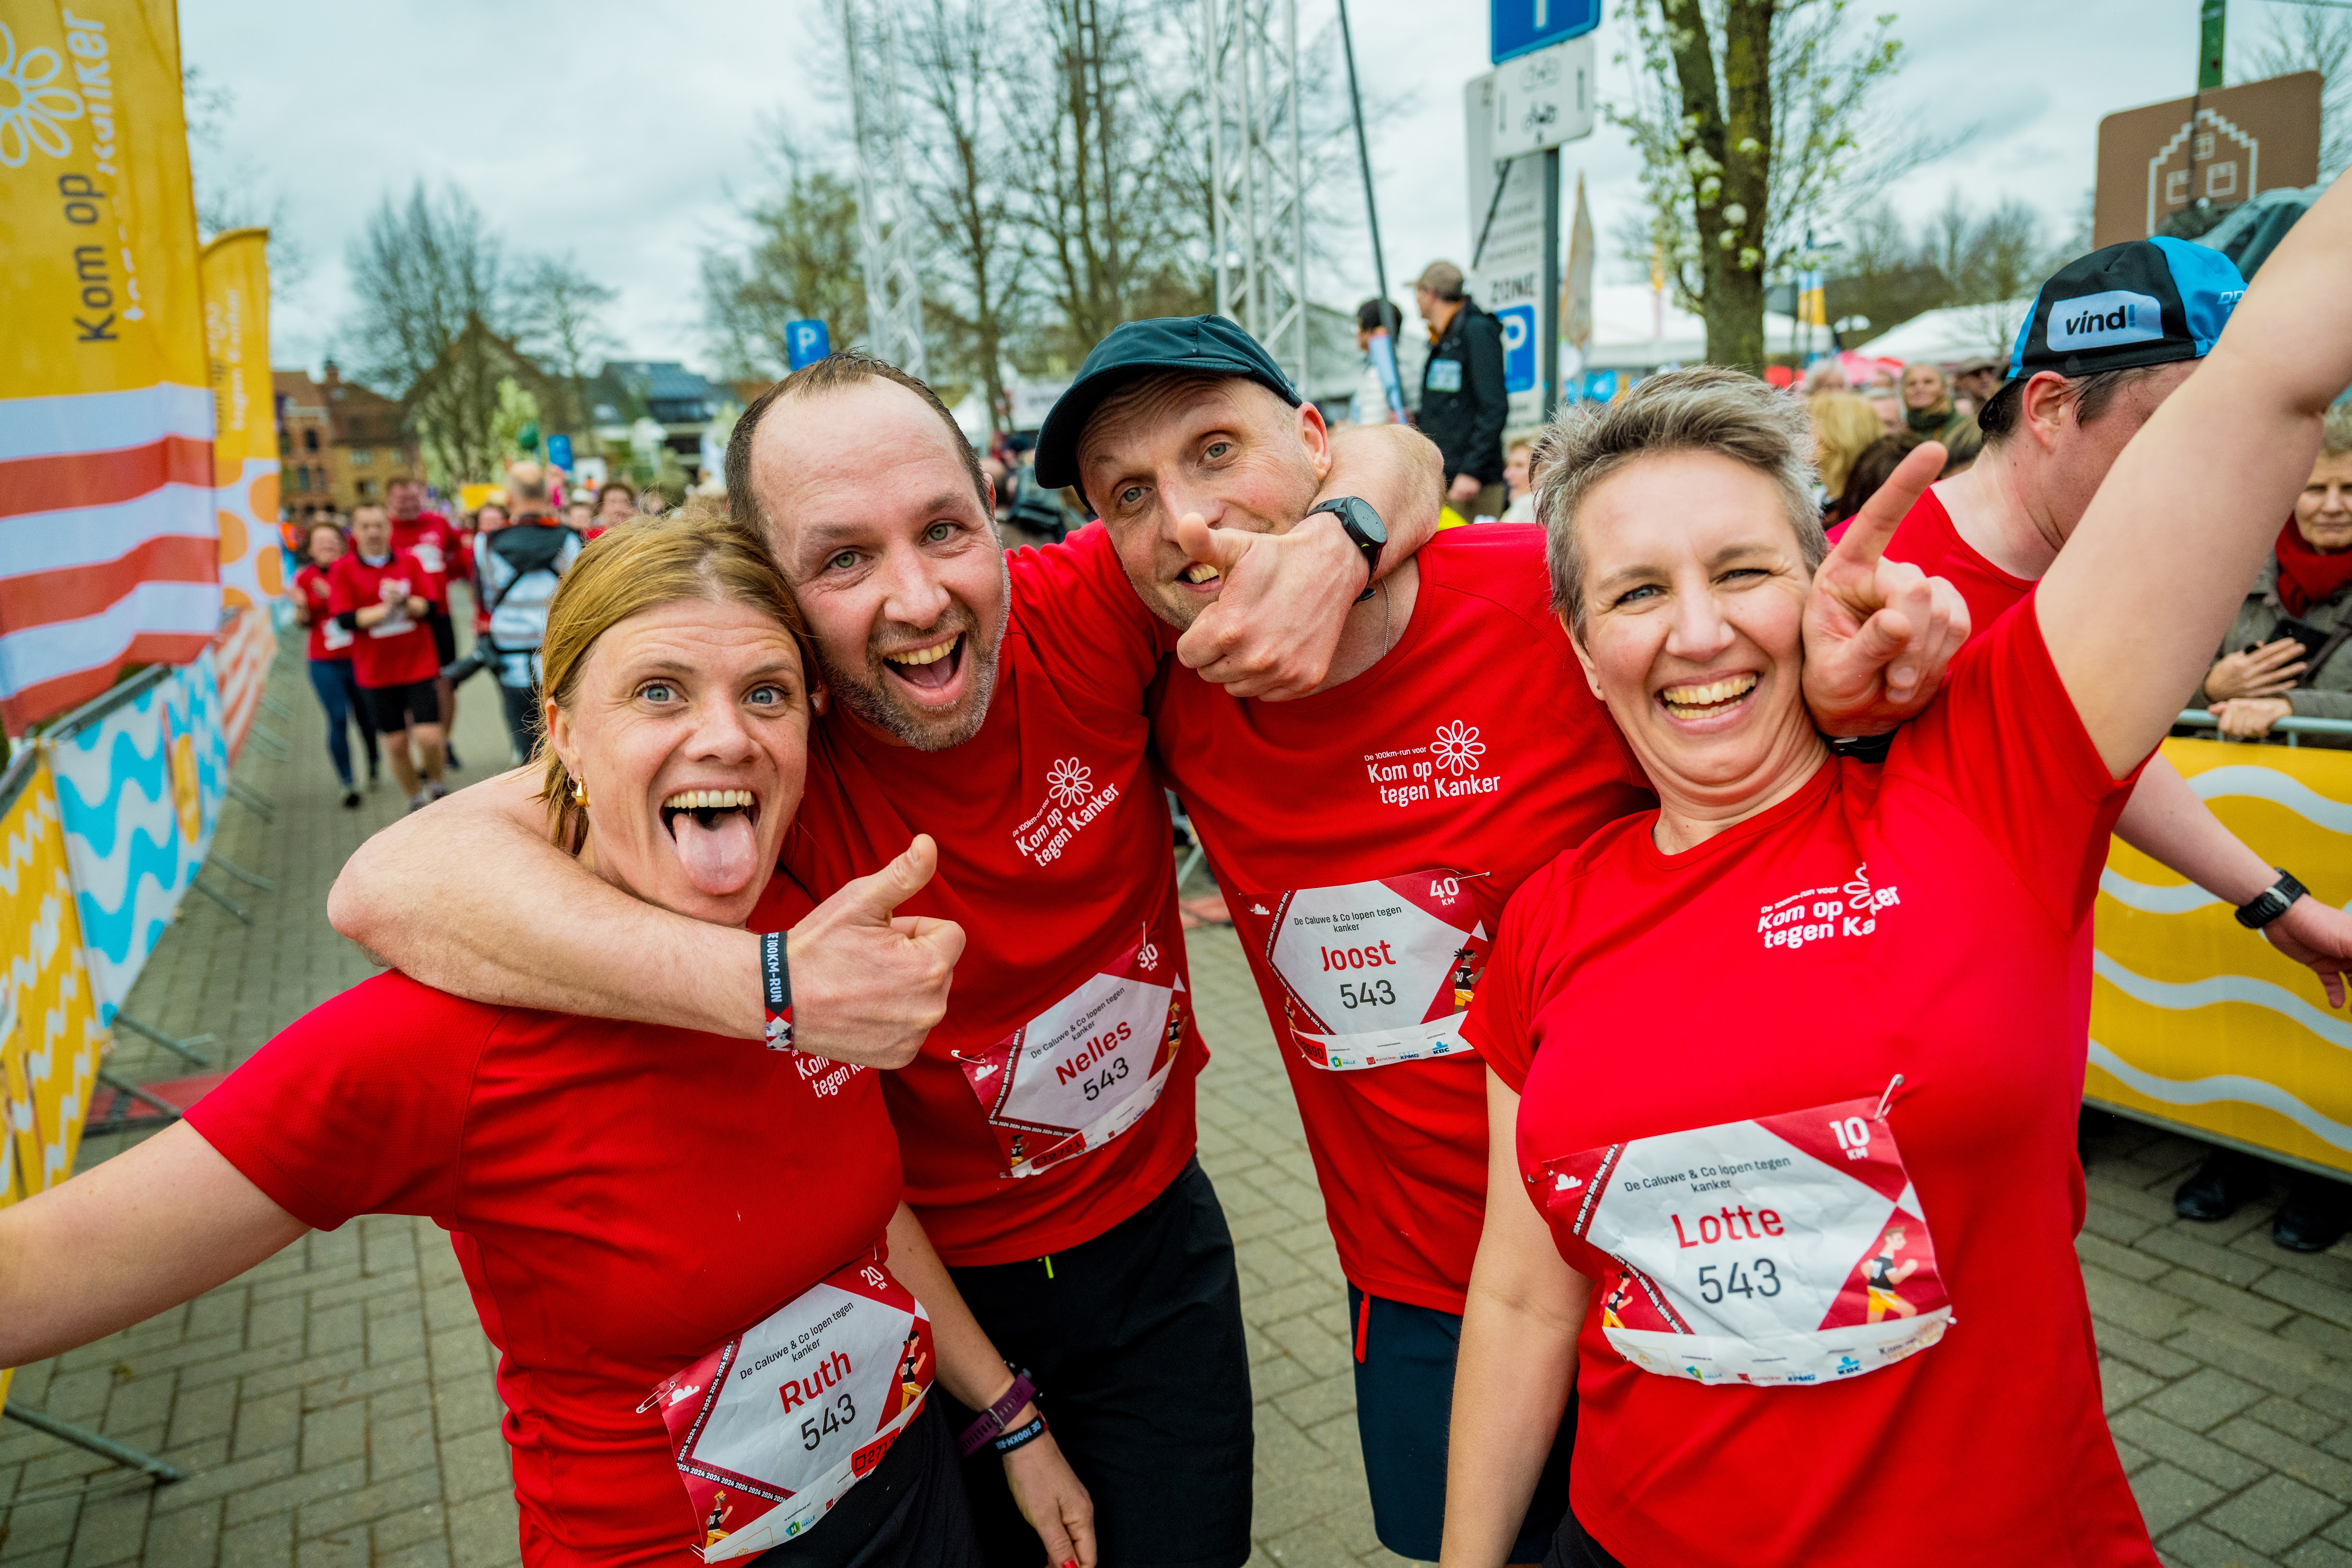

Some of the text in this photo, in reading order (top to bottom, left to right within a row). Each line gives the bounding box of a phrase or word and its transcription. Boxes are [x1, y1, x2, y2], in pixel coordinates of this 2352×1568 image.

[58, 172, 119, 343] Kom op
[2066, 304, 2135, 336] vind!
[798, 327, 816, 354] P
[1375, 749, 1411, 760] 100km-run
[1367, 761, 1432, 783] Kom op
[1380, 774, 1501, 807] tegen Kanker
[1012, 798, 1050, 837] De 100km-run voor
[1015, 808, 1063, 856] Kom op
[1034, 783, 1119, 867] tegen Kanker
[1430, 877, 1459, 898] 40
[1442, 897, 1455, 906] KM
[1305, 916, 1331, 924] Caluwe
[1340, 913, 1350, 922] Co
[1352, 911, 1375, 921] lopen
[1376, 906, 1402, 917] tegen
[1333, 923, 1359, 932] kanker
[1757, 900, 1843, 933] Kom op
[1764, 886, 1901, 949] tegen Kaker
[767, 939, 782, 1003] 100KM-RUN
[1137, 943, 1158, 968] 30
[1148, 960, 1158, 972] KM
[1321, 940, 1396, 972] Joost
[1340, 980, 1396, 1009] 543
[1031, 1049, 1042, 1058] De
[1043, 1030, 1069, 1051] Caluwe
[1076, 1017, 1086, 1026] Co
[1086, 1003, 1105, 1019] lopen
[1105, 987, 1125, 1004] tegen
[1072, 1021, 1095, 1041] kanker
[1055, 1021, 1131, 1086] Nelles
[812, 1066, 849, 1098] tegen
[1083, 1057, 1128, 1101] 543
[1829, 1117, 1870, 1150] 10
[1049, 1140, 1080, 1160] 2721
[1846, 1147, 1868, 1160] KM
[1625, 1157, 1791, 1192] De Caluwe & Co lopen tegen
[1691, 1179, 1732, 1192] kanker
[1671, 1205, 1784, 1248] Lotte
[861, 1266, 884, 1286] 20
[877, 1281, 887, 1290] KM
[1699, 1258, 1781, 1303] 543
[740, 1302, 854, 1379] De Caluwe & Co lopen tegen
[791, 1338, 820, 1362] kanker
[779, 1351, 851, 1414] Ruth
[678, 1345, 732, 1461] 2024 2024 2024 2024 2024 2024 2024
[801, 1394, 855, 1450] 543
[1031, 1420, 1041, 1433] DE
[690, 1468, 705, 1477] 2024
[705, 1472, 720, 1482] 2024
[720, 1477, 735, 1487] 2024
[735, 1482, 748, 1491] 2024
[748, 1486, 761, 1495] 2024
[761, 1491, 774, 1499] 2024
[801, 1515, 815, 1528] HALLE
